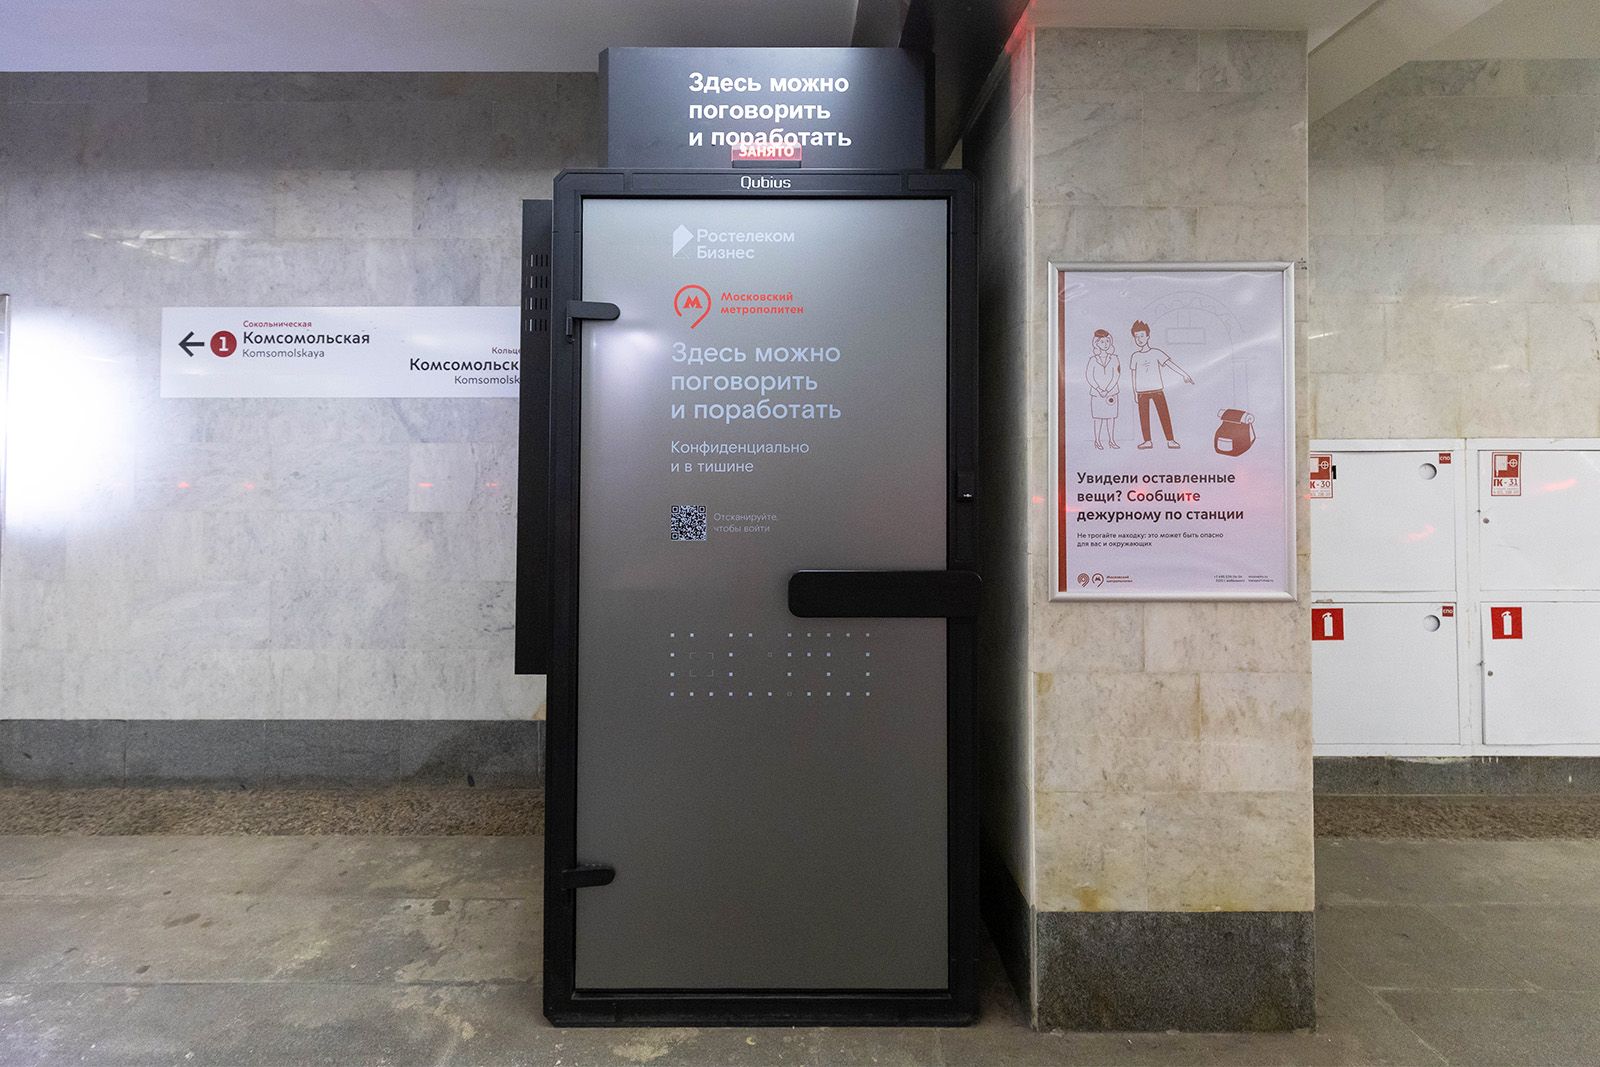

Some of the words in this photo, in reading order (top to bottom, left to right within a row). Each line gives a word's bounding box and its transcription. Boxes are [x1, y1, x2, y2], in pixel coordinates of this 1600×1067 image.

[688, 72, 762, 93] Здесь
[770, 77, 849, 92] можно
[689, 104, 831, 122] поговорить
[689, 132, 703, 146] и
[711, 128, 852, 149] поработать
[738, 145, 795, 157] ЗАНЯТО
[740, 176, 792, 189] Qubius
[697, 229, 795, 243] Ростелеком
[697, 245, 755, 259] Бизнес
[720, 291, 793, 302] Московский
[720, 306, 805, 316] метрополитен
[243, 320, 312, 329] Сокольническая
[243, 331, 370, 344] Комсомольская
[218, 337, 229, 352] 1
[242, 348, 325, 359] Komsomolskaya
[671, 342, 747, 365] Здесь
[755, 347, 841, 362] можно
[410, 358, 520, 371] Комсомольск
[454, 374, 521, 385] Komsomolsk
[671, 375, 818, 395] поговорить
[671, 404, 685, 419] и
[694, 399, 842, 424] поработать
[671, 440, 809, 455] Конфиденциально
[671, 461, 679, 472] и
[685, 461, 692, 472] в
[698, 461, 754, 472] тишине
[1077, 472, 1138, 485] Увидели
[1142, 473, 1236, 484] оставленные
[1077, 490, 1122, 504] вещи?
[1126, 490, 1201, 504] Сообщите
[713, 512, 777, 521] Отсканируйте
[1077, 509, 1161, 523] дежурному
[1165, 510, 1182, 520] по
[1186, 509, 1244, 522] станции
[714, 524, 741, 533] чтобы
[744, 524, 770, 533] войти
[1088, 532, 1117, 540] трогайте
